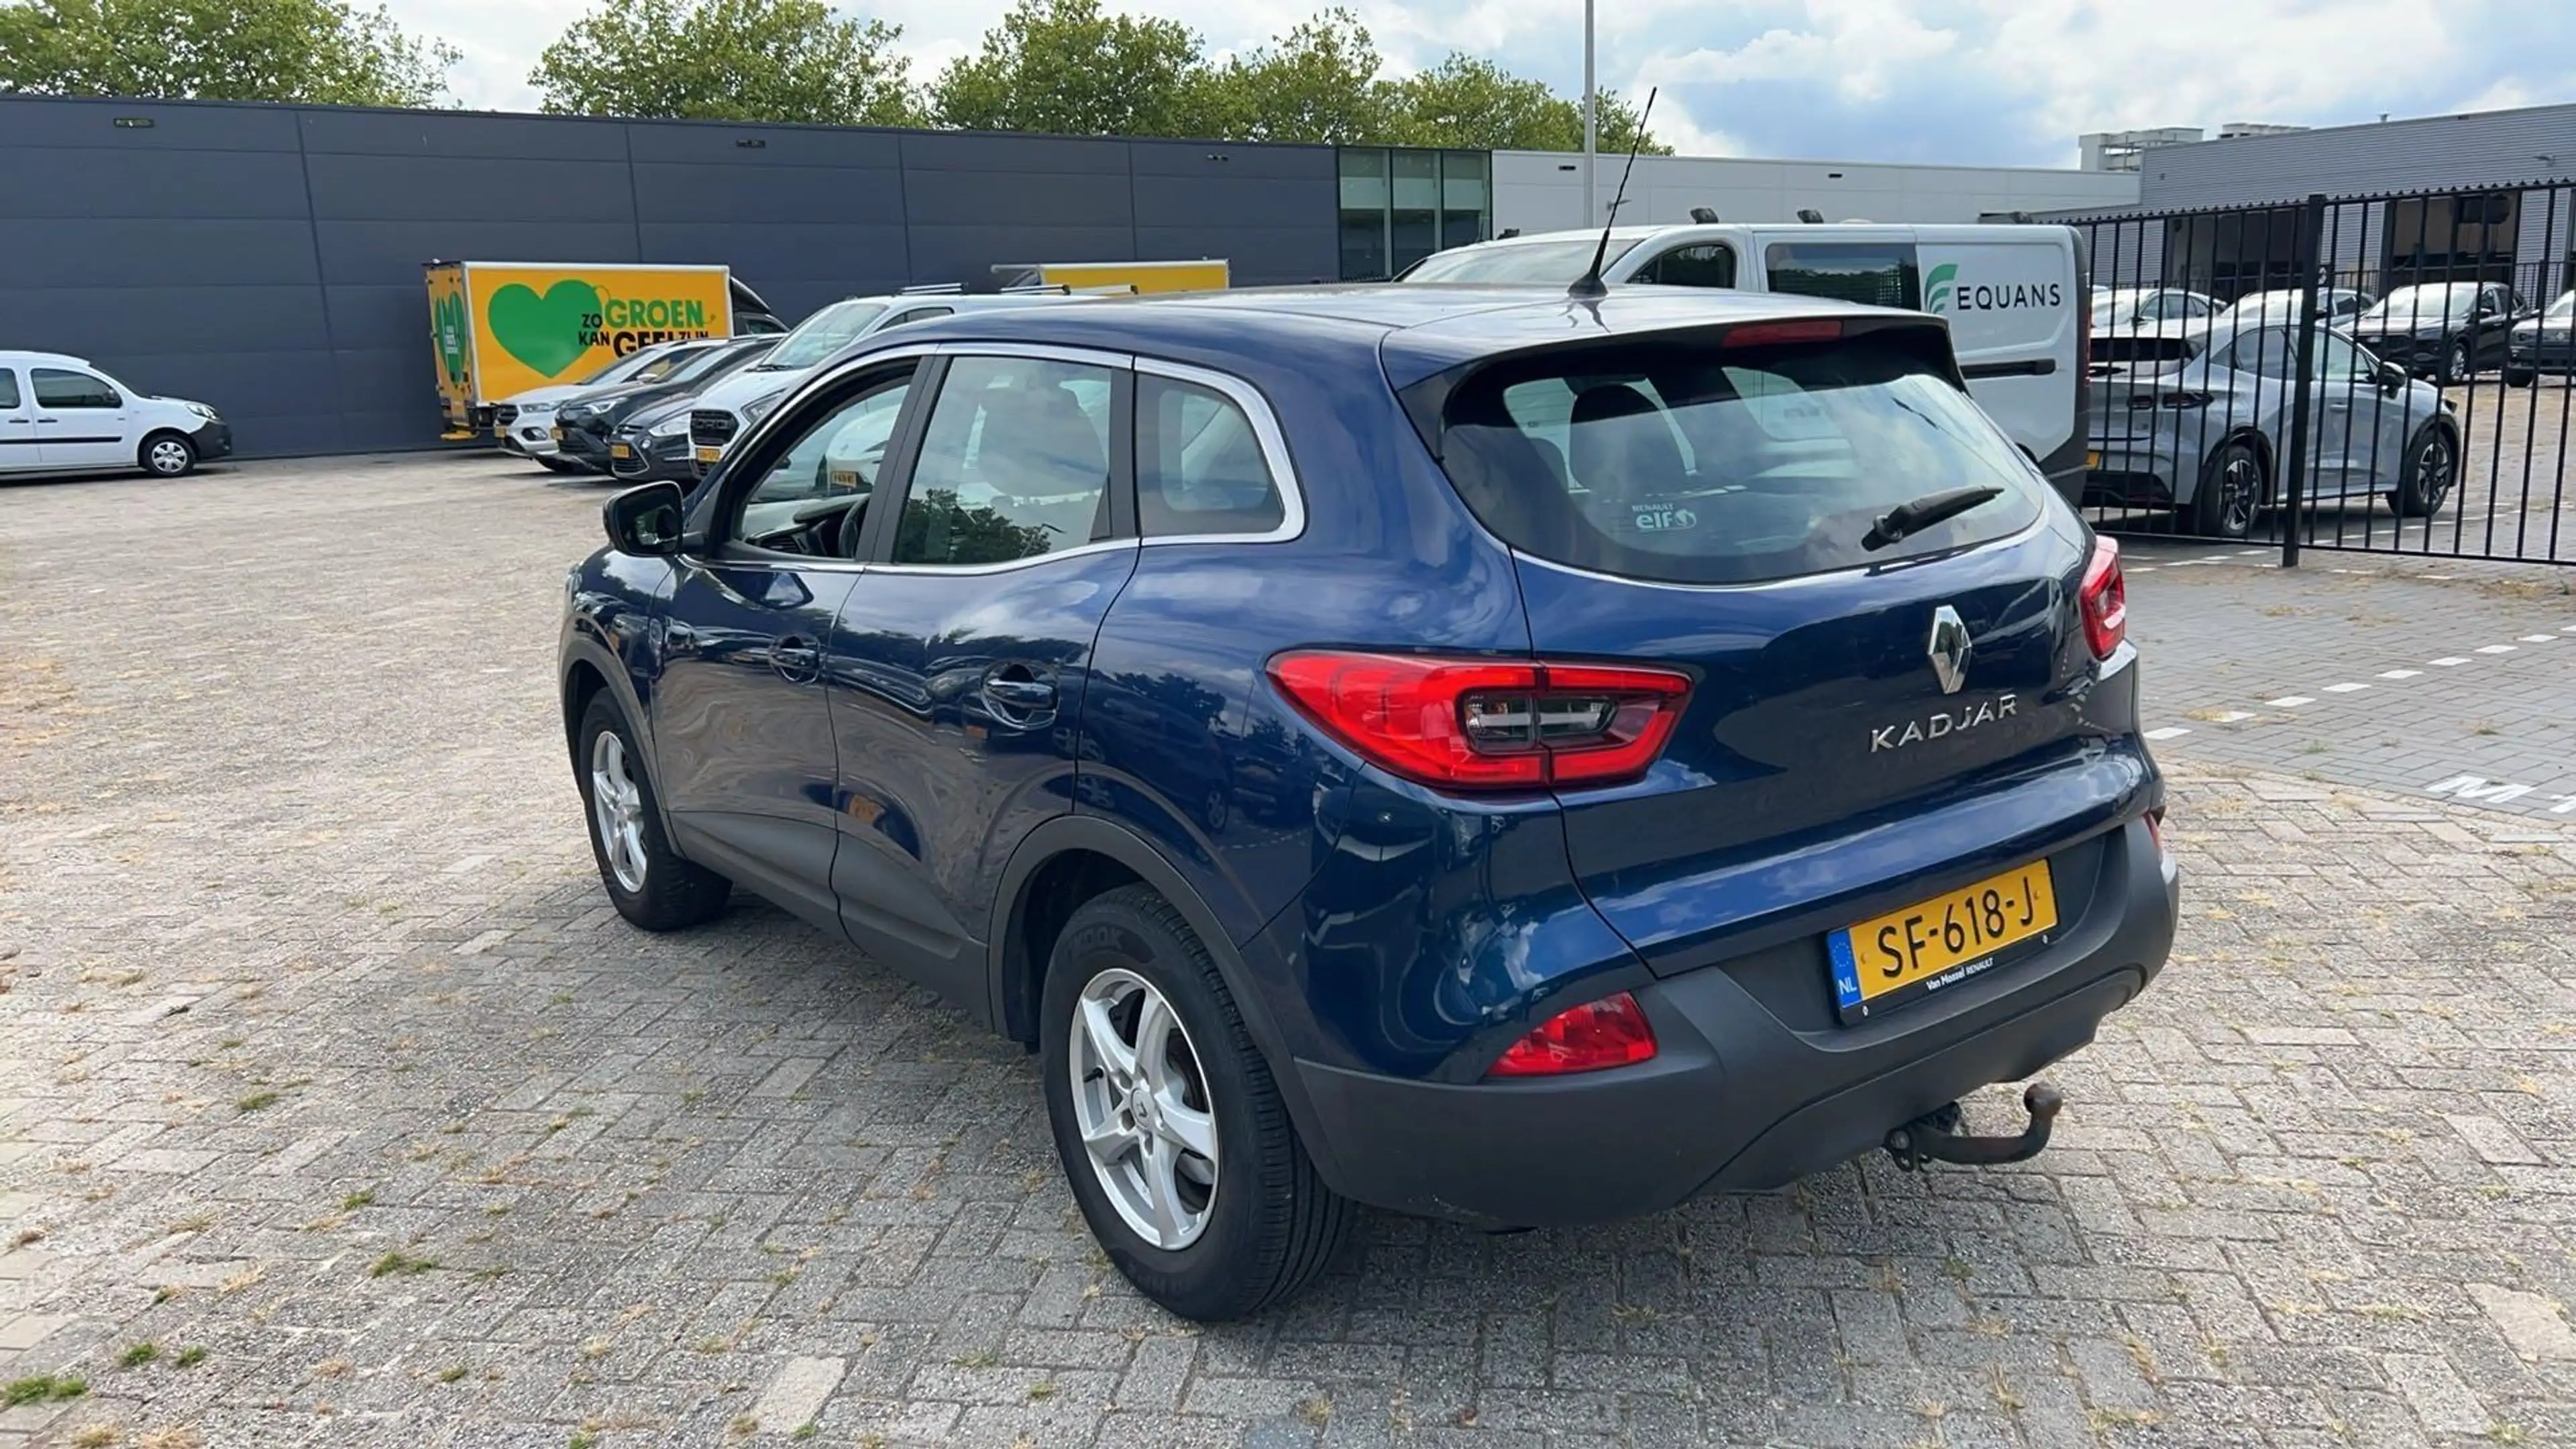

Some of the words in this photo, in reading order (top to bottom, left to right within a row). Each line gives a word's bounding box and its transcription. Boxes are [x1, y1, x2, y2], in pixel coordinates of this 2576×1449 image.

[1957, 282, 2061, 311] EQUANS
[581, 313, 603, 328] ZO
[604, 299, 704, 328] GROEN
[578, 331, 610, 345] KAN
[1635, 511, 1672, 529] elf
[1870, 694, 2017, 753] KADJAR
[1878, 876, 2033, 978] SF-618-J
[1838, 976, 1858, 996] NL
[1926, 979, 1941, 991] Van
[1965, 957, 1994, 975] RENAULT
